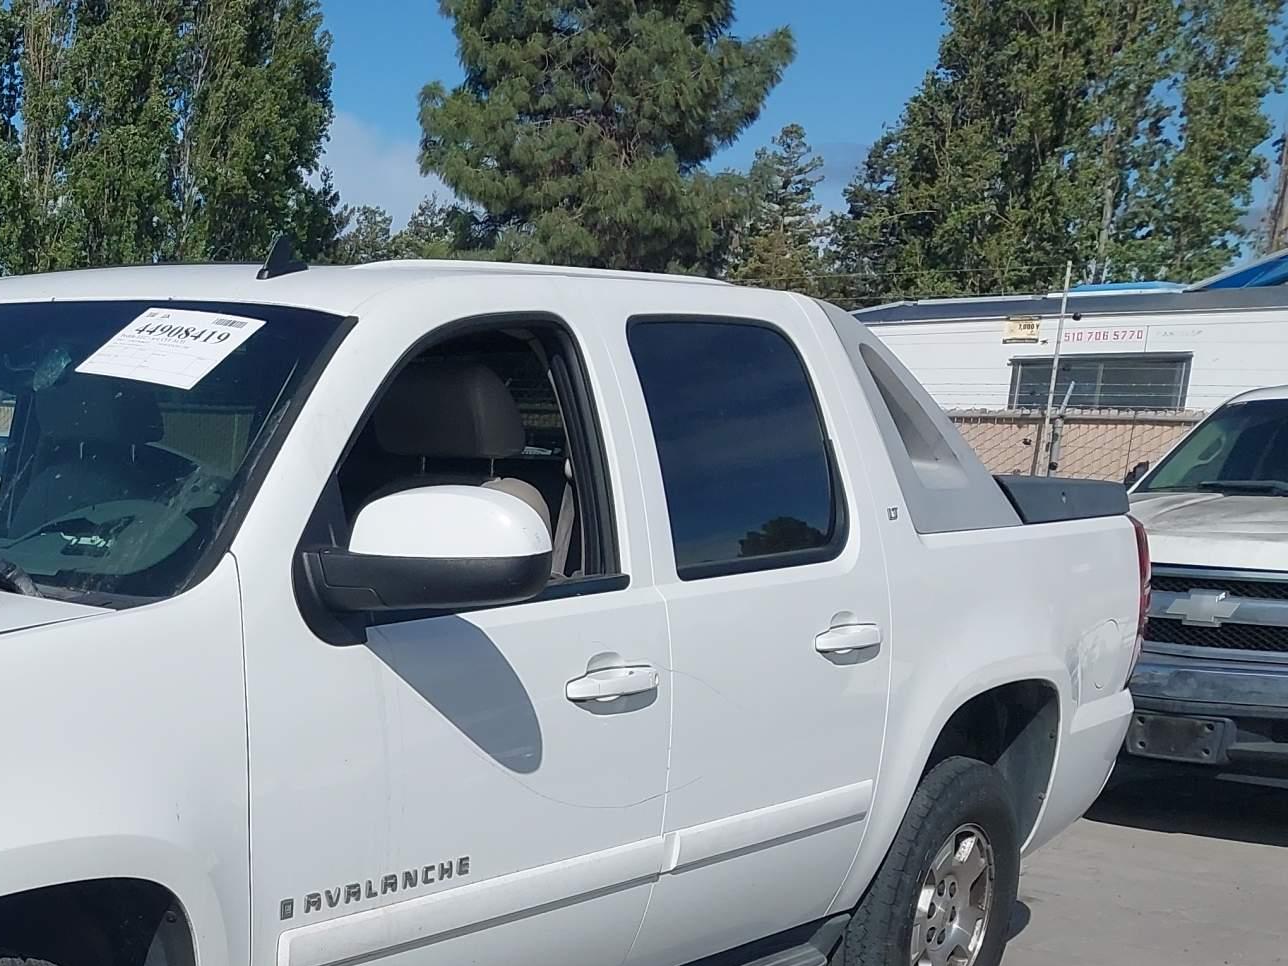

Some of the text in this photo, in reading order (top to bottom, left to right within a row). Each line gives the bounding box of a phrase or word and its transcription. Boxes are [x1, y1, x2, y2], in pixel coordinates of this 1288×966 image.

[135, 322, 231, 345] 44908419
[1064, 331, 1083, 342] 510
[1087, 331, 1109, 341] 706
[1112, 329, 1144, 340] 5770
[304, 856, 470, 914] AVALANCHE
